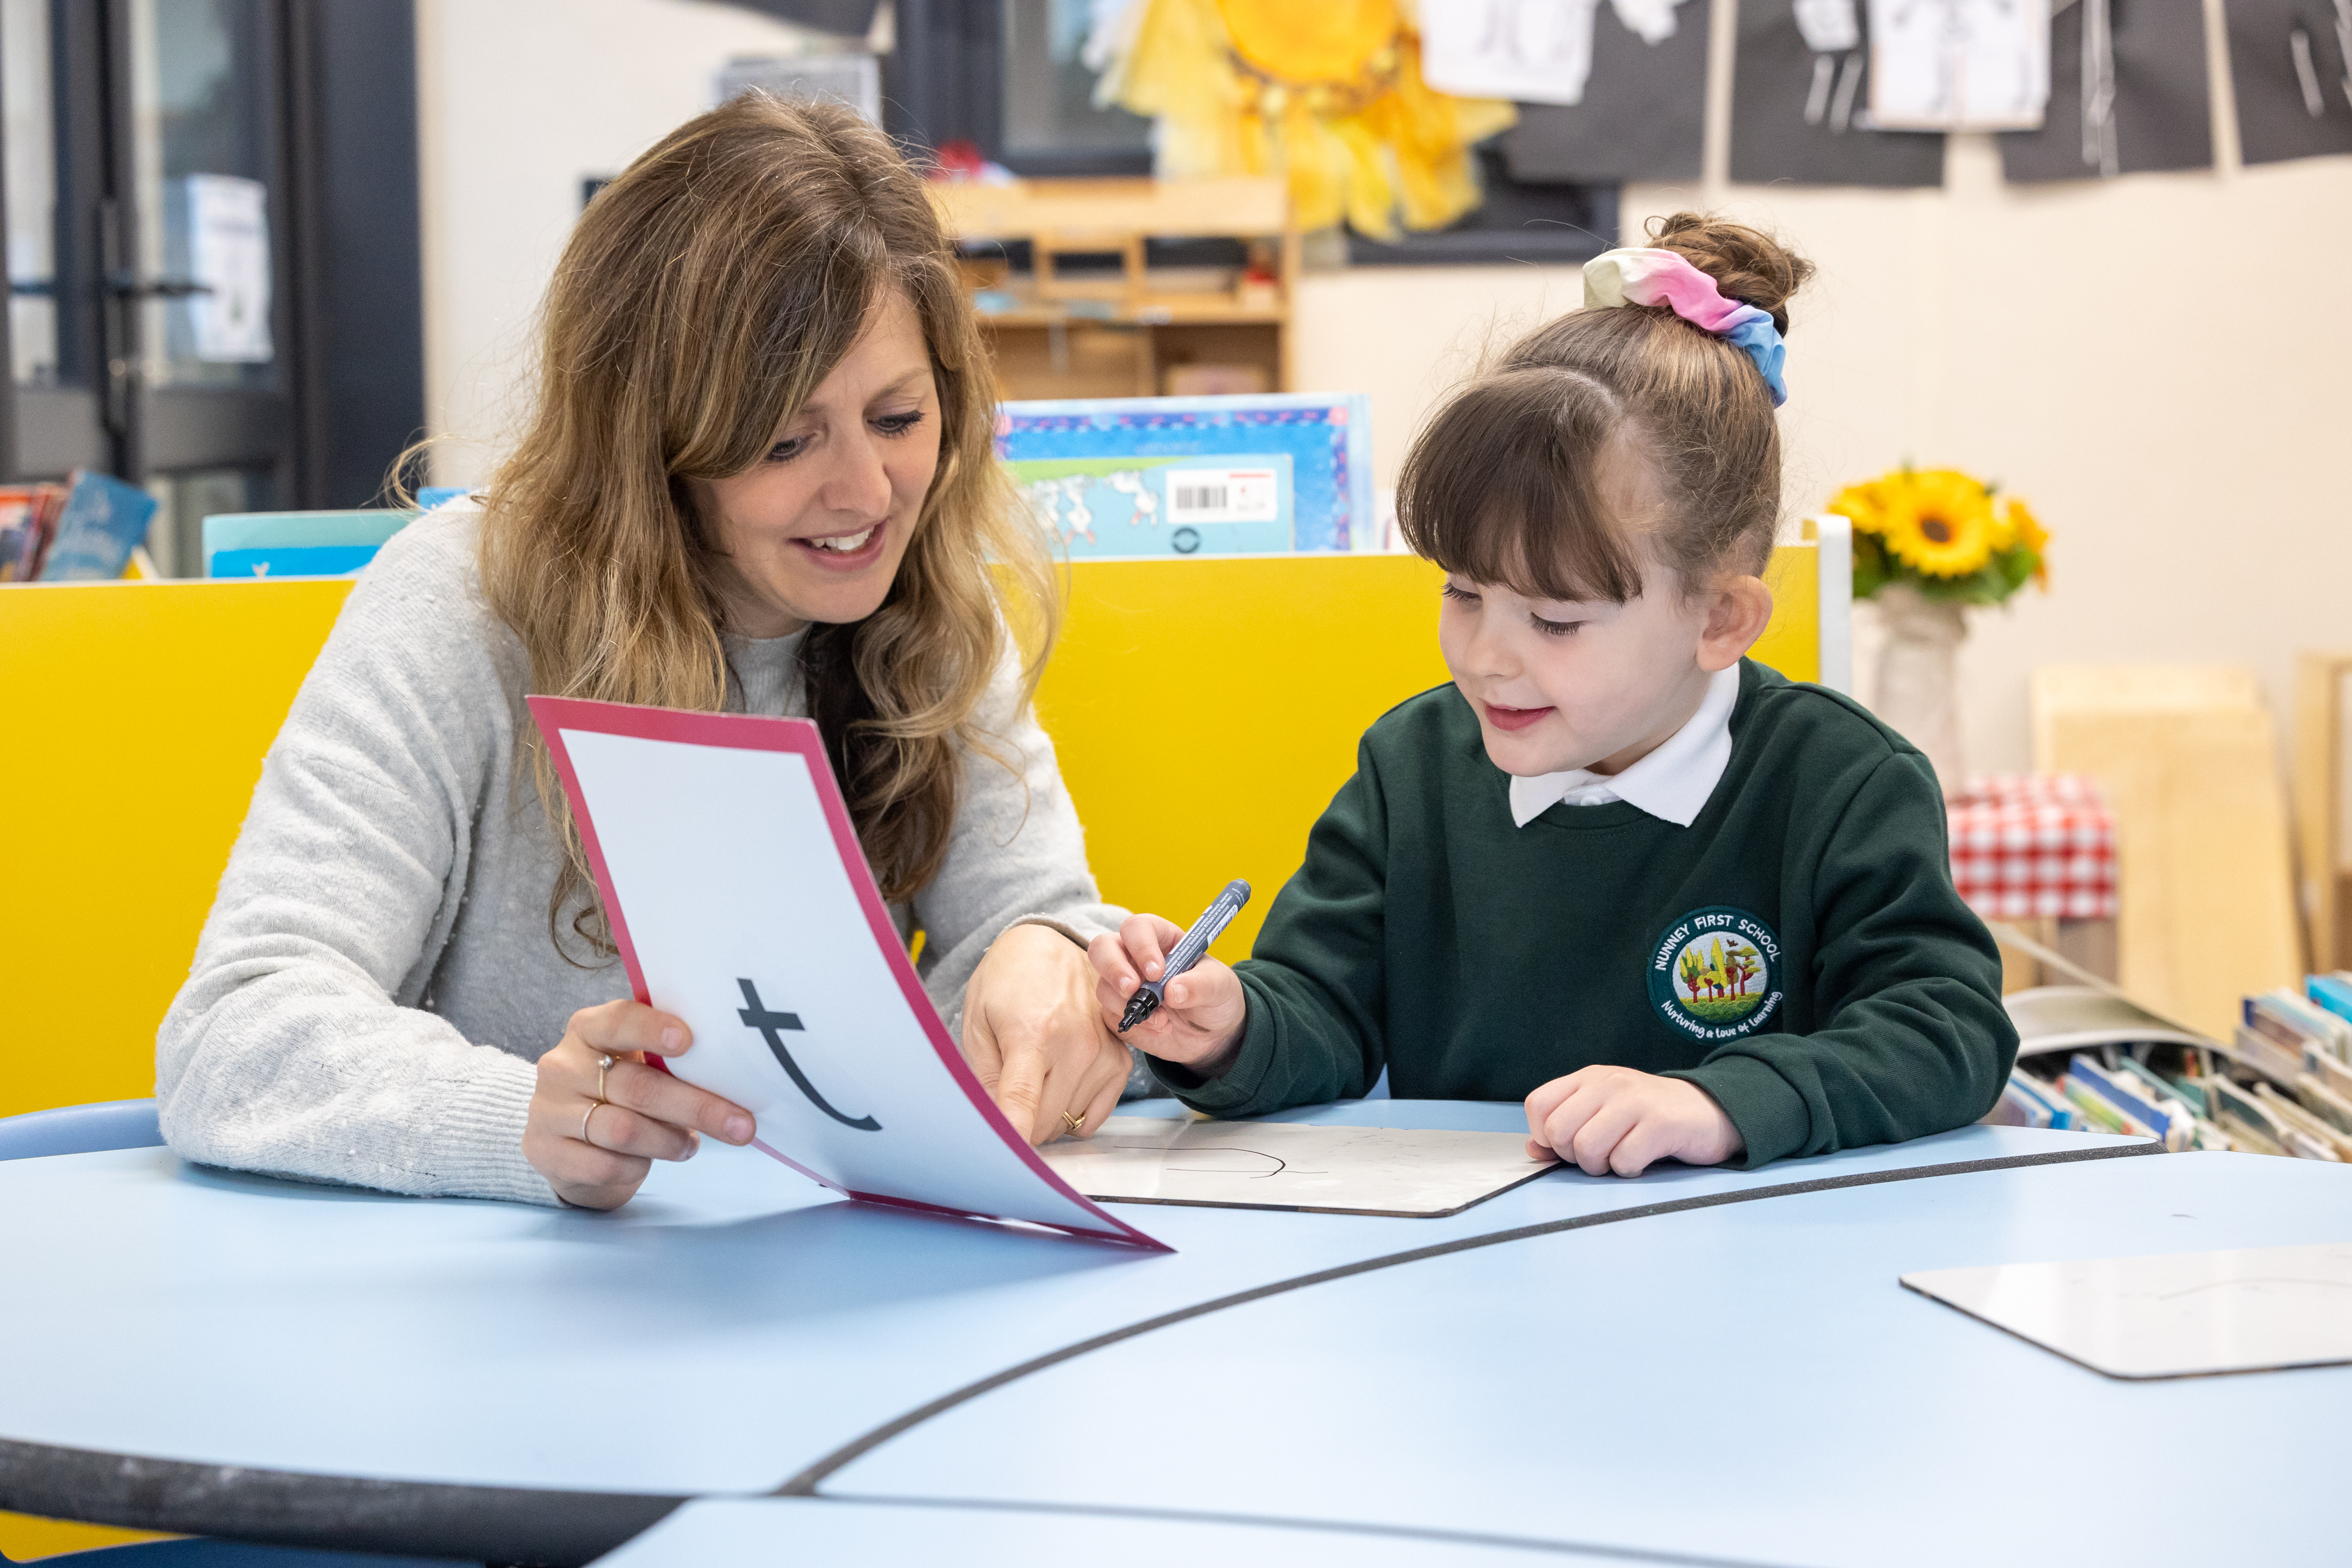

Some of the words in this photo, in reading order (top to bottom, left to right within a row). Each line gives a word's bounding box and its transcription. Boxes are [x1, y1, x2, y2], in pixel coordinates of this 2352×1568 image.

[1655, 924, 1690, 971] NUNNEY
[1694, 915, 1734, 929] FIRST
[1738, 919, 1781, 962] SCHOOL
[1661, 1000, 1705, 1039] Nurturing
[1716, 1028, 1736, 1038] love
[1738, 1023, 1750, 1033] of
[1748, 991, 1783, 1027] learning
[736, 978, 883, 1131] t
